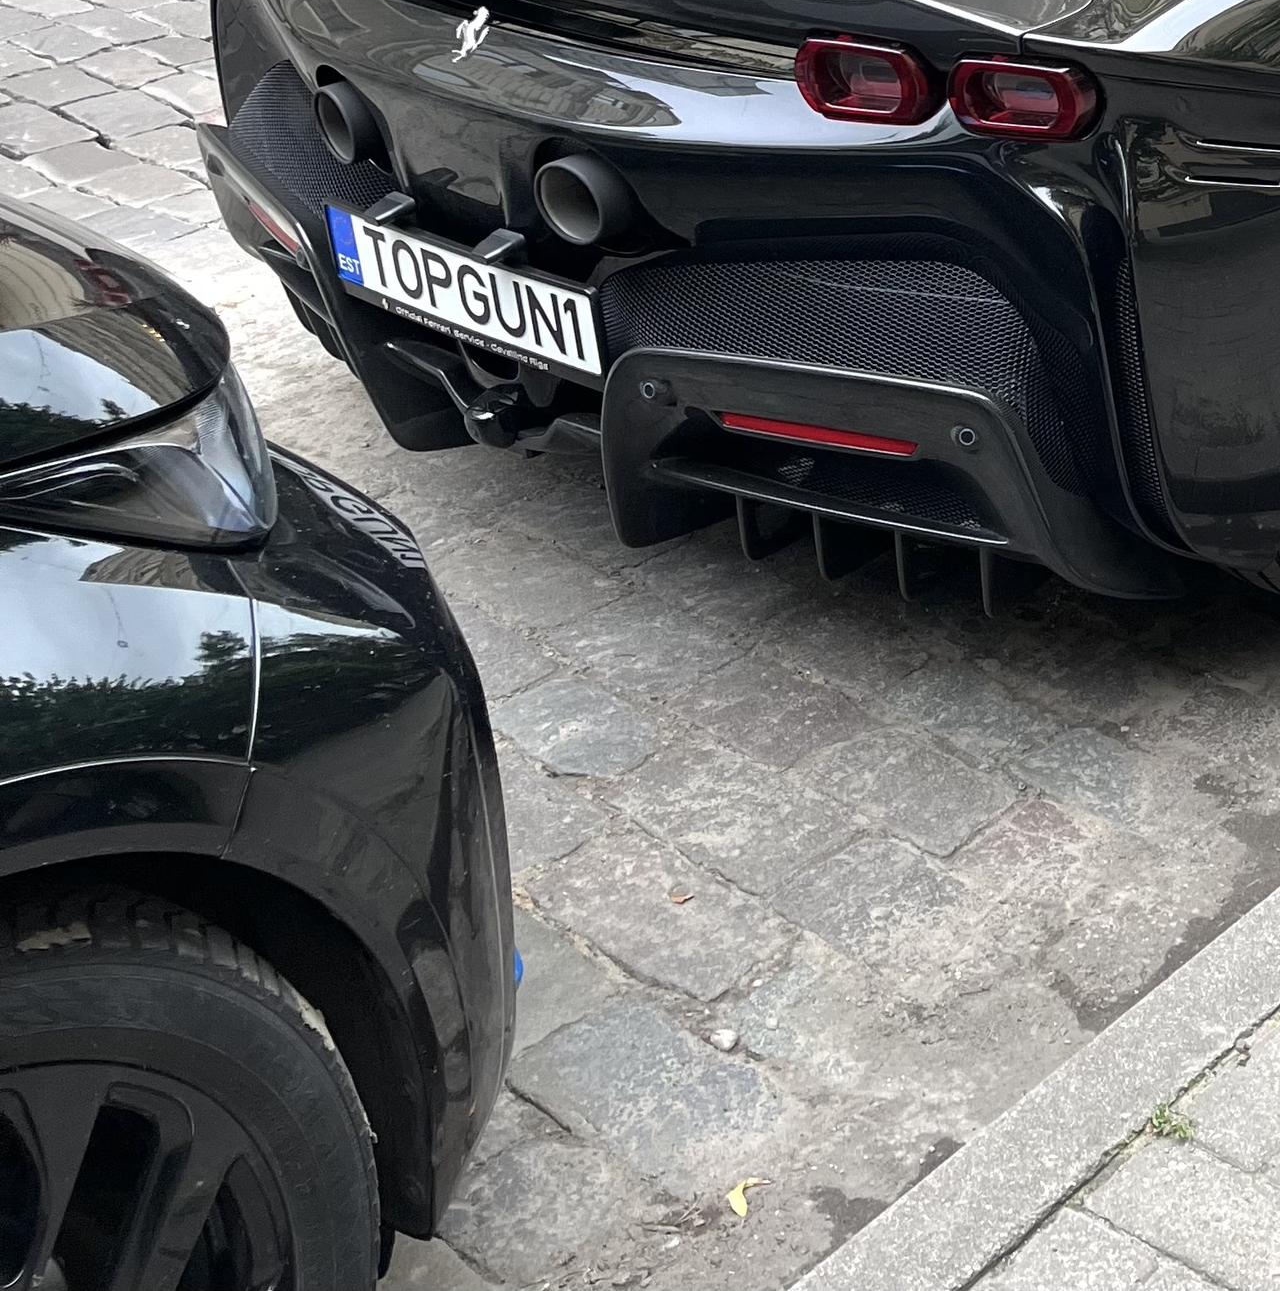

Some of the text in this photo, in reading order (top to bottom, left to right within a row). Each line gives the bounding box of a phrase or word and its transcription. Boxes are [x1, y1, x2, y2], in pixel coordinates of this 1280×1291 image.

[338, 254, 361, 276] EST
[363, 225, 586, 361] TOPGUN1
[396, 306, 423, 324] Official
[424, 317, 452, 335] Ferrari
[454, 329, 485, 347] Service
[528, 357, 549, 371] Riga
